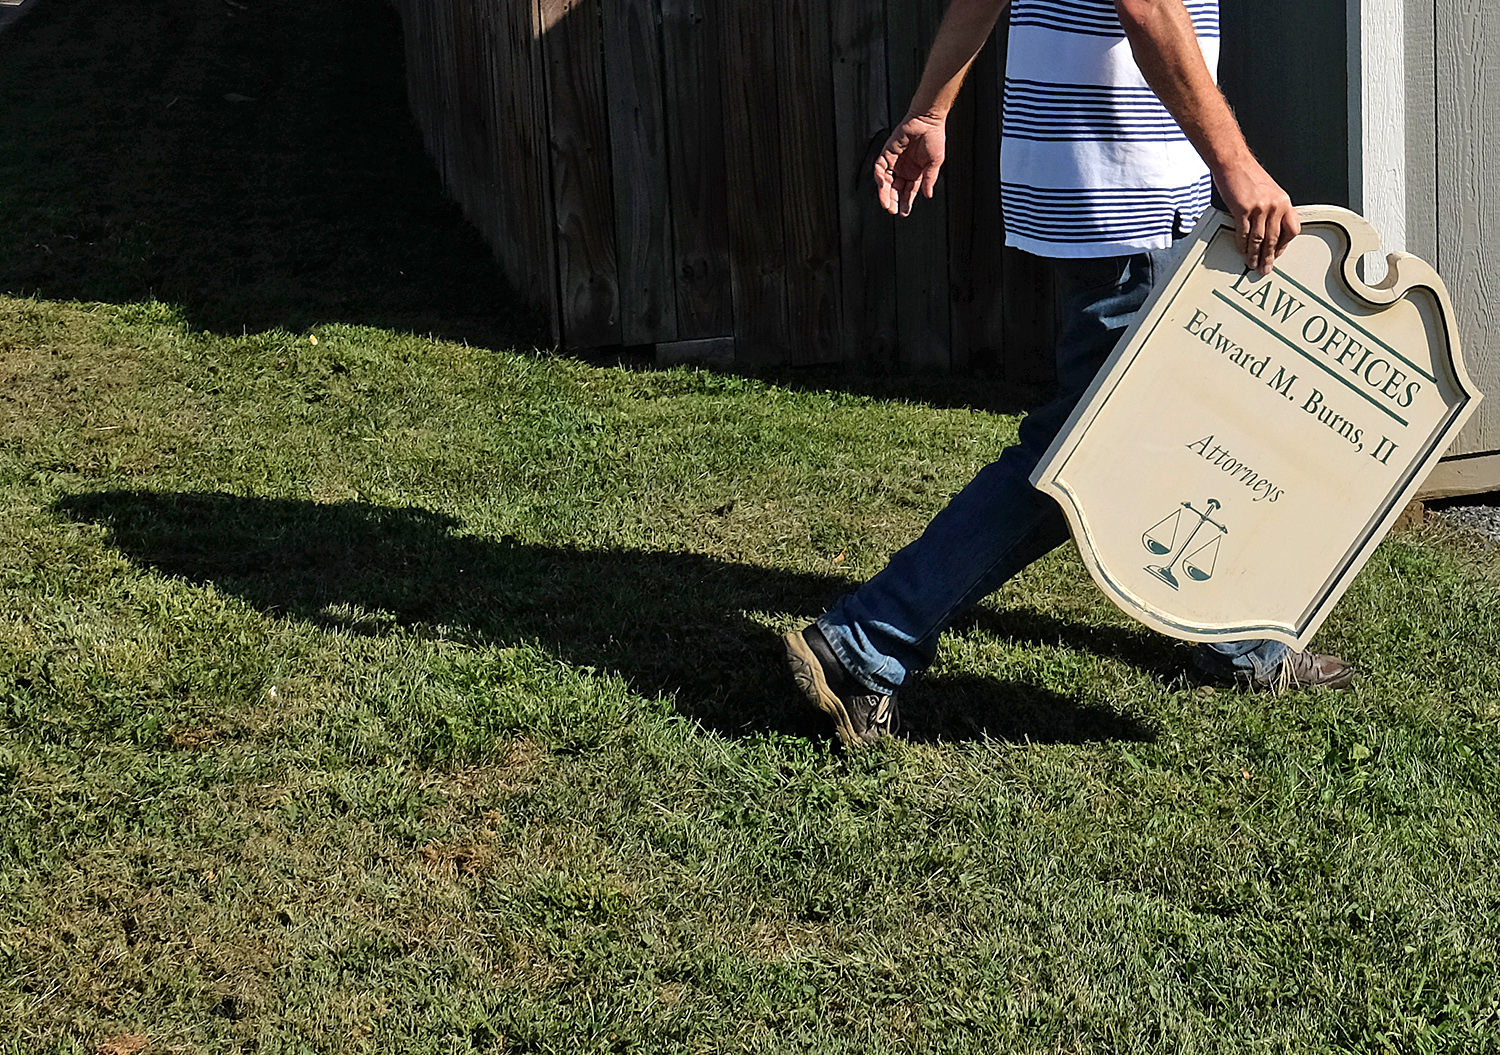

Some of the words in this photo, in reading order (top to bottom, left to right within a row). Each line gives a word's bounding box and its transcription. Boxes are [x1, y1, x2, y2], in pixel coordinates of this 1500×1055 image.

[1183, 308, 1271, 379] Edward
[1267, 365, 1299, 402] M.
[1300, 388, 1364, 453] Burns,
[1370, 435, 1399, 466] II
[1229, 263, 1306, 324] LAW
[1302, 315, 1421, 409] OFFICES
[1186, 434, 1285, 503] Attorneys
